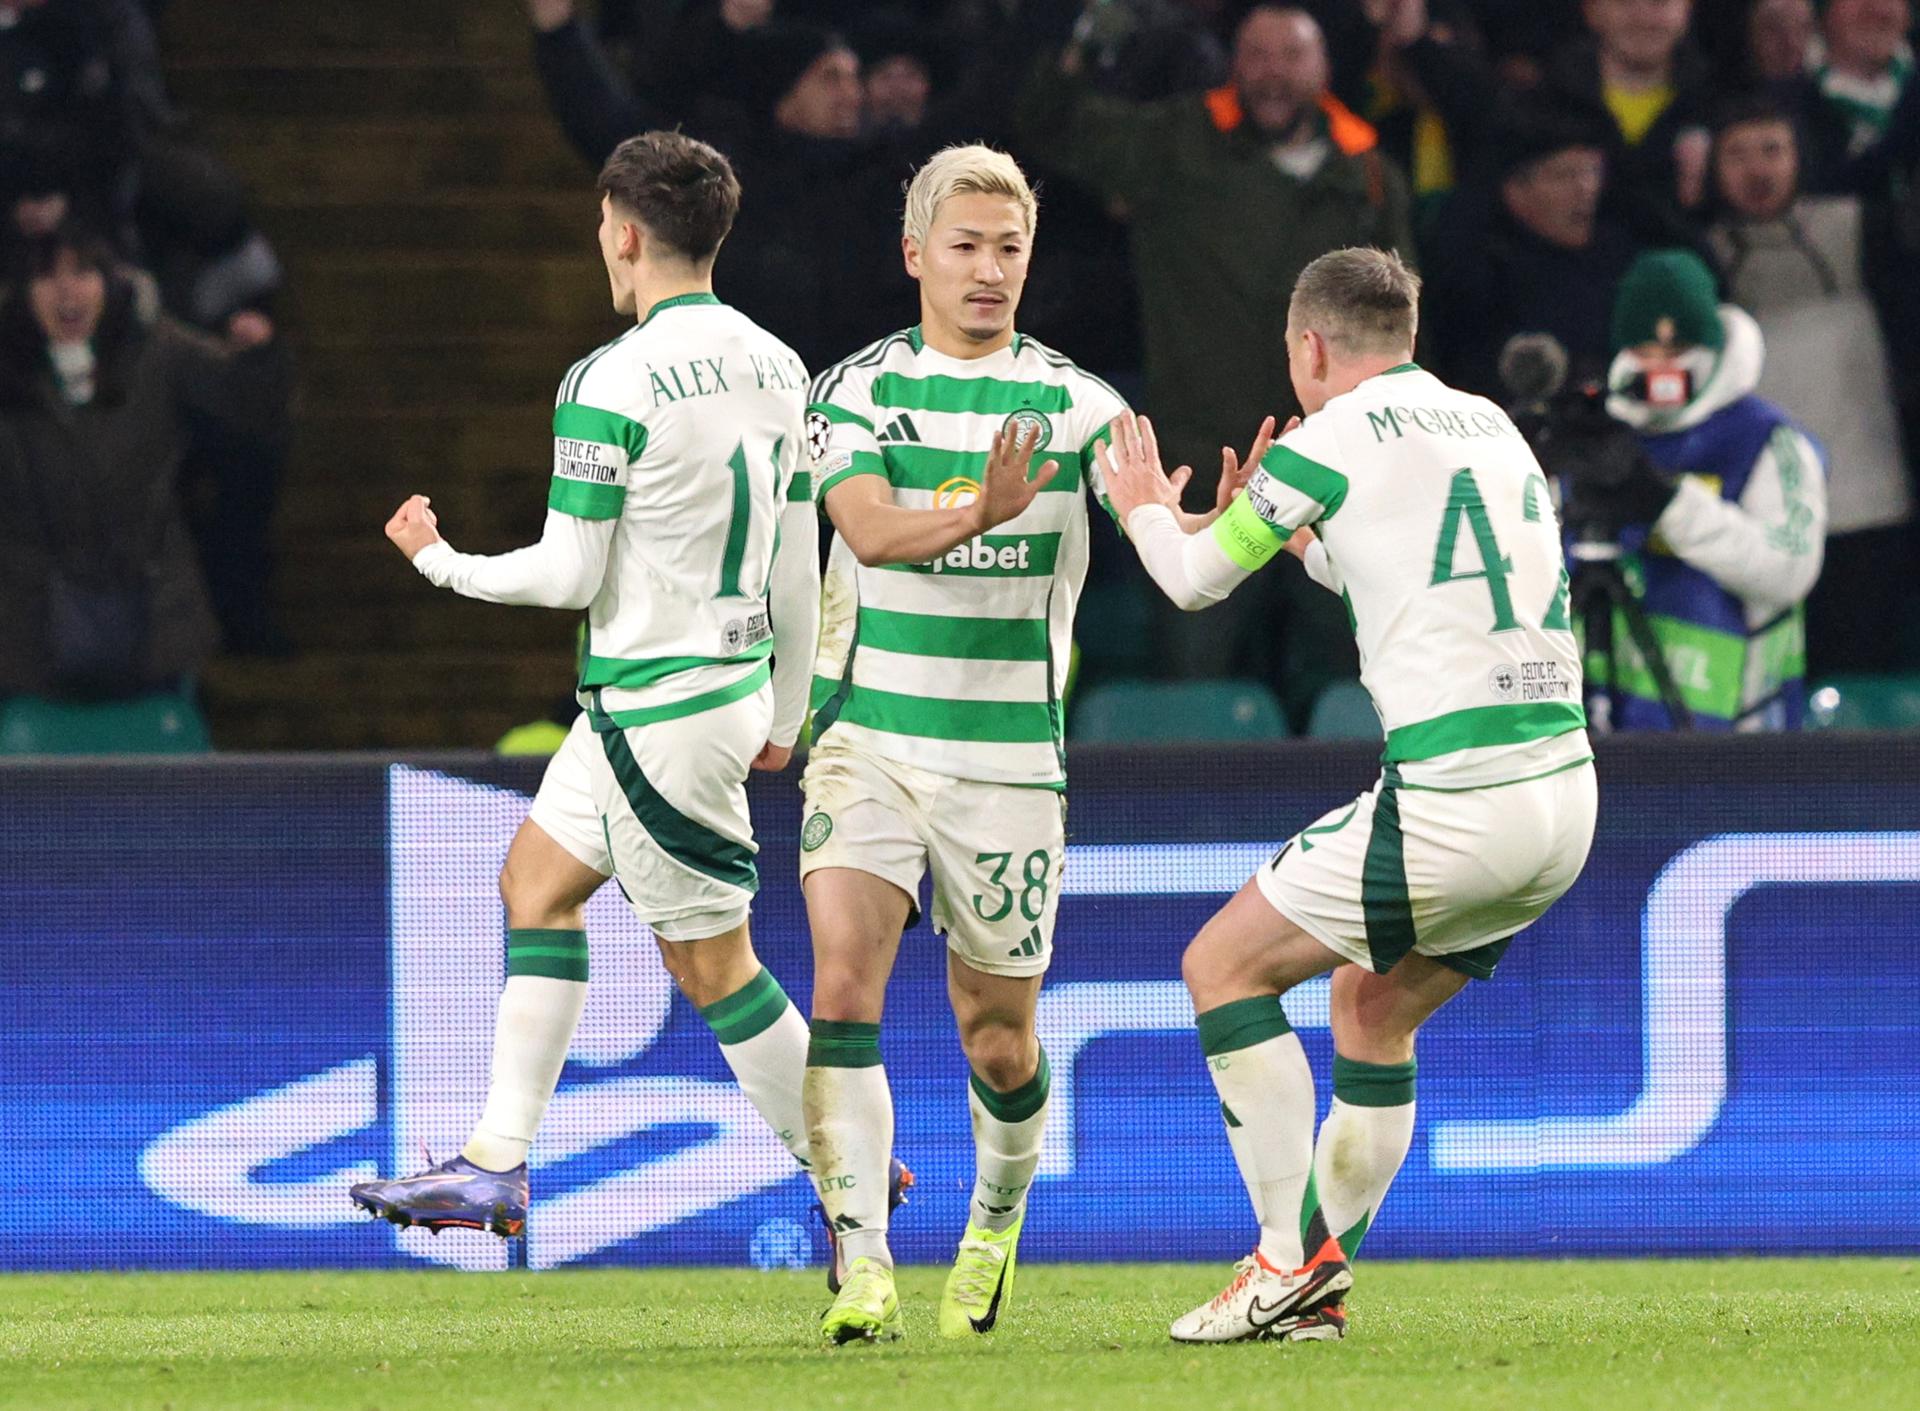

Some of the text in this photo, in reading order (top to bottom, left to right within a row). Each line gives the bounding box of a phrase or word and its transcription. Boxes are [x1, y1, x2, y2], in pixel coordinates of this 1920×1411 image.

[586, 444, 601, 462] FC
[1428, 467, 1572, 635] 42
[1521, 661, 1557, 681] CELTIC FC
[973, 849, 1050, 922] 38
[819, 1174, 857, 1194] LTIC
